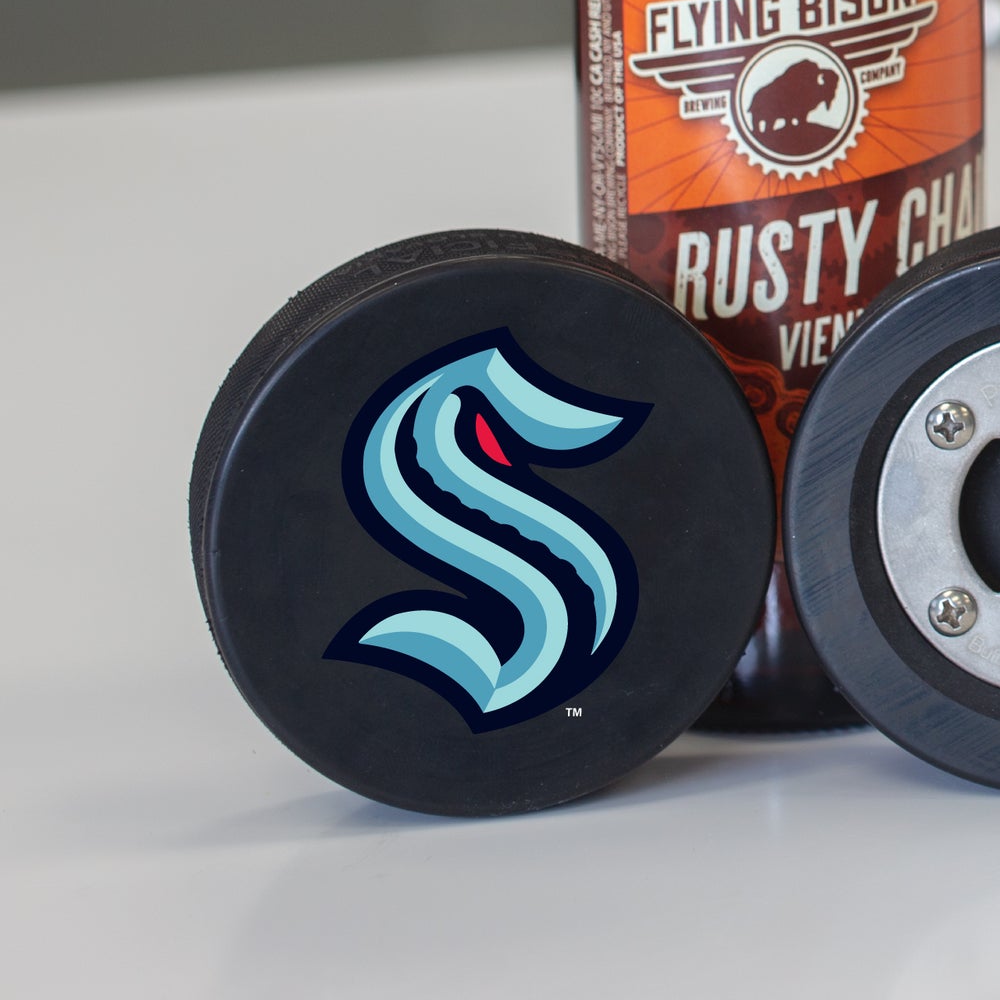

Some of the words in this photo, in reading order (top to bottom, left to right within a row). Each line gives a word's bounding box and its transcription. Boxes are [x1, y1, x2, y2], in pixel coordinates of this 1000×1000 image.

[589, 20, 603, 63] CASH
[611, 30, 623, 58] USA
[612, 59, 624, 84] THE
[860, 63, 901, 85] COMPANY
[613, 85, 624, 104] OF
[684, 96, 727, 113] BREWING
[614, 105, 625, 167] PRODUCT
[674, 199, 878, 321] RUSTY
[565, 707, 582, 717] TM
